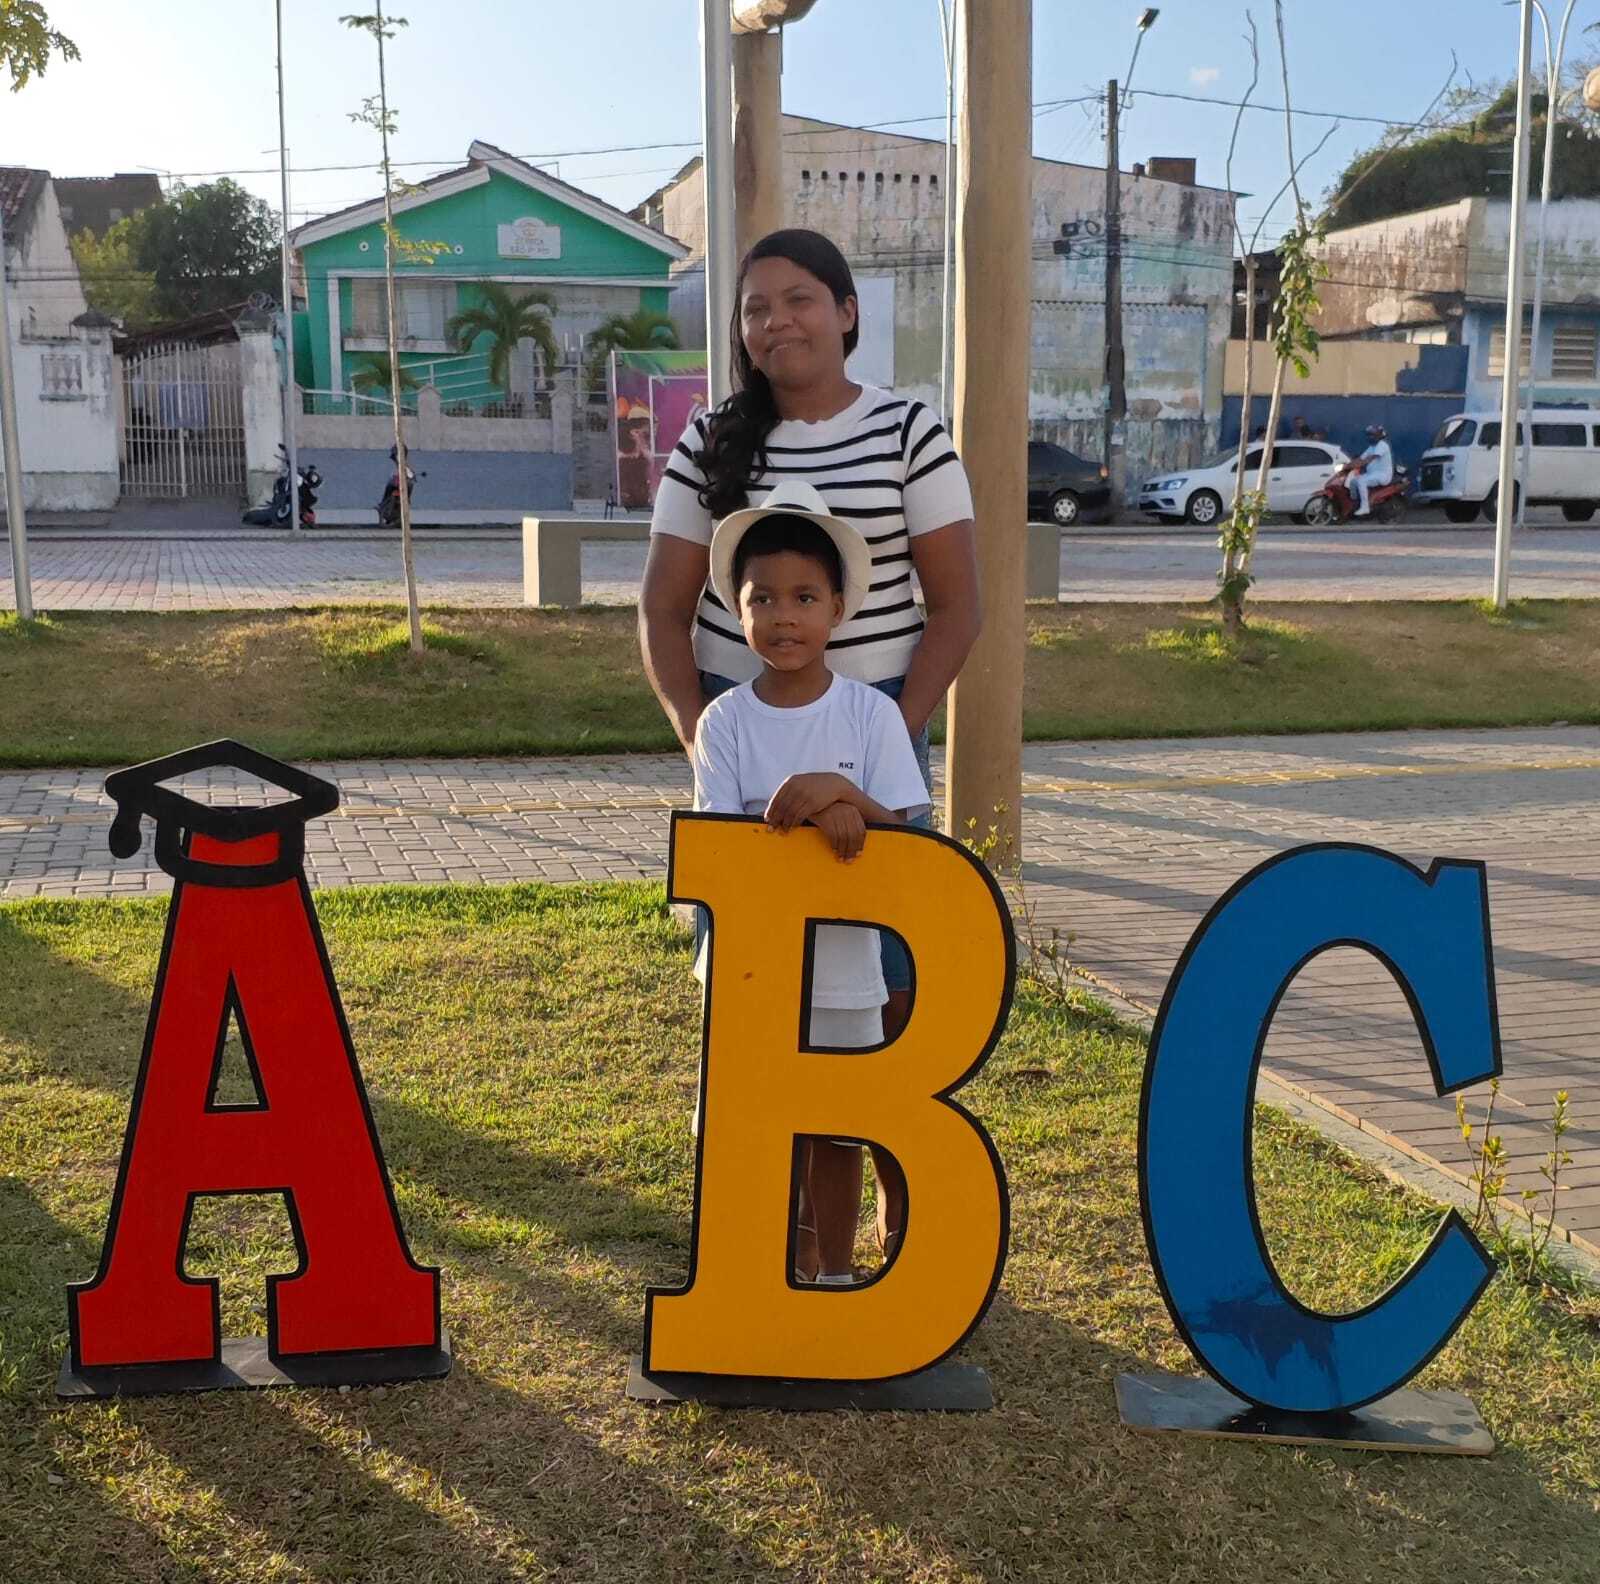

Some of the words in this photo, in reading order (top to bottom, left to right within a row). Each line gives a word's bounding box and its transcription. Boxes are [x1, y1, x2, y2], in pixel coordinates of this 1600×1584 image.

[67, 800, 441, 1372] A
[642, 809, 1016, 1382] B
[1137, 841, 1503, 1412] C
